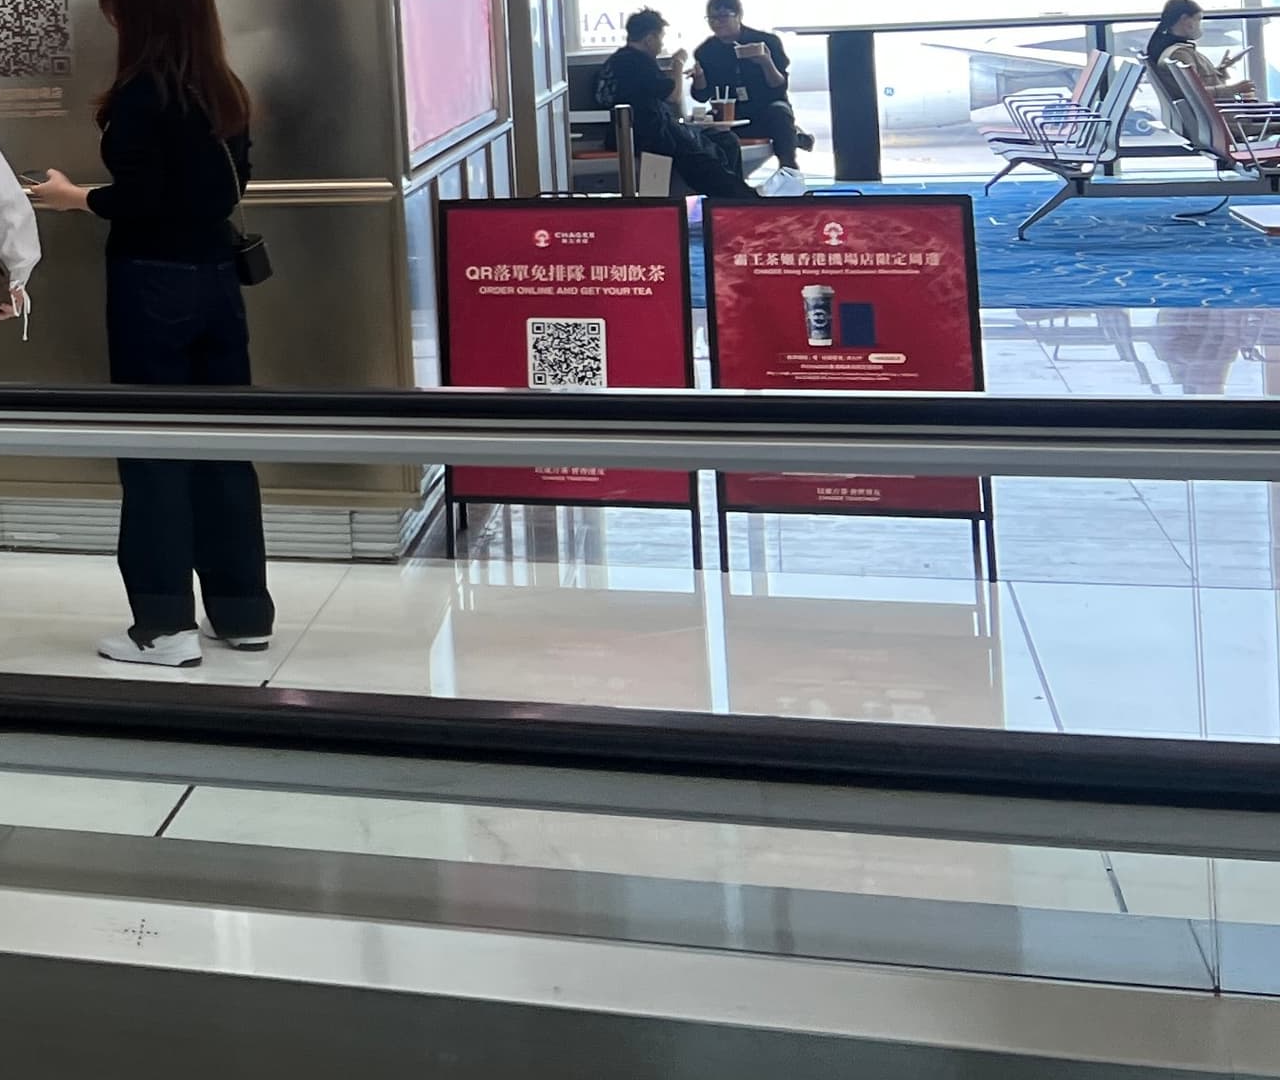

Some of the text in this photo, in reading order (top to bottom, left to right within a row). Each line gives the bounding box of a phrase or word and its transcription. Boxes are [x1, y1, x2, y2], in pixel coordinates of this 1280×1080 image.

[479, 286, 653, 295] ORDER ONLINE AND GET YOUR TEA
